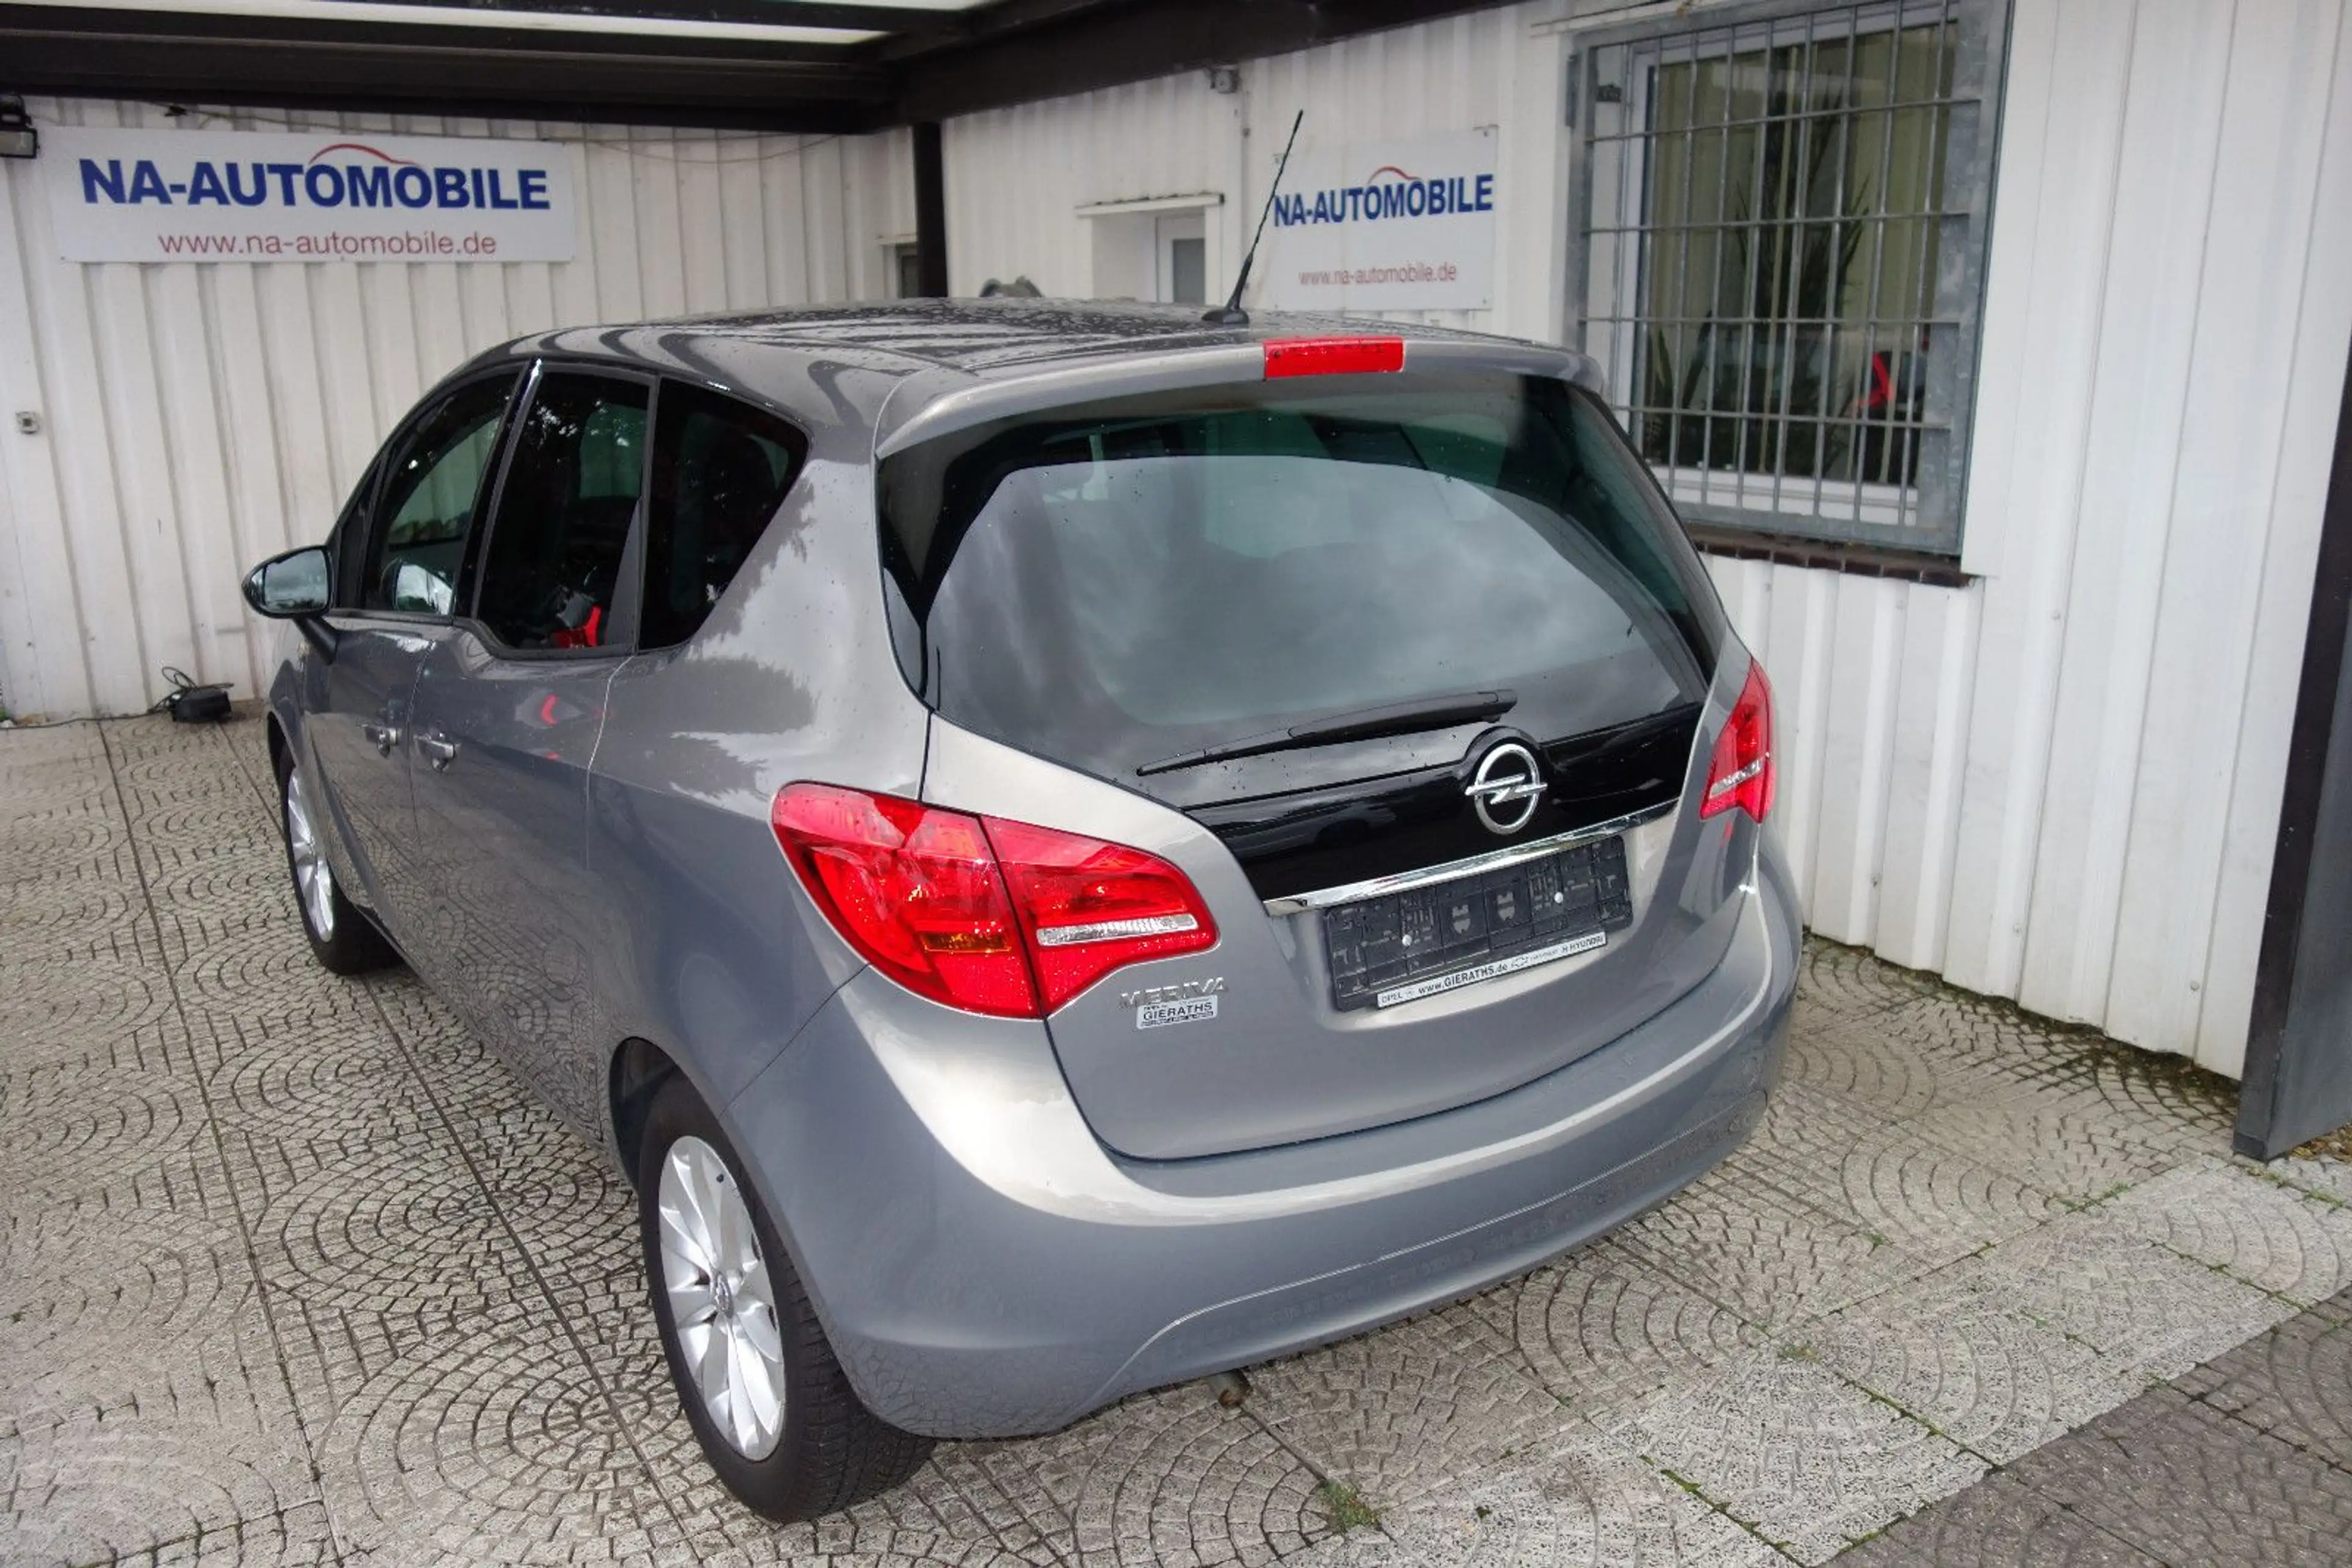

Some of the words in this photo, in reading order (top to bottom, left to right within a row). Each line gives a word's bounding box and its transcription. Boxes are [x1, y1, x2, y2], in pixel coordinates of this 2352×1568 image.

[79, 159, 550, 209] NA-AUTOMOBILE
[1274, 174, 1493, 227] NA-AUTOMOBILE
[159, 232, 497, 255] www.na-automobile.de
[1298, 262, 1457, 285] www.na-automobile.de
[1419, 966, 1508, 994] www.GIERATHS.de
[1143, 1002, 1213, 1021] GIERATHS
